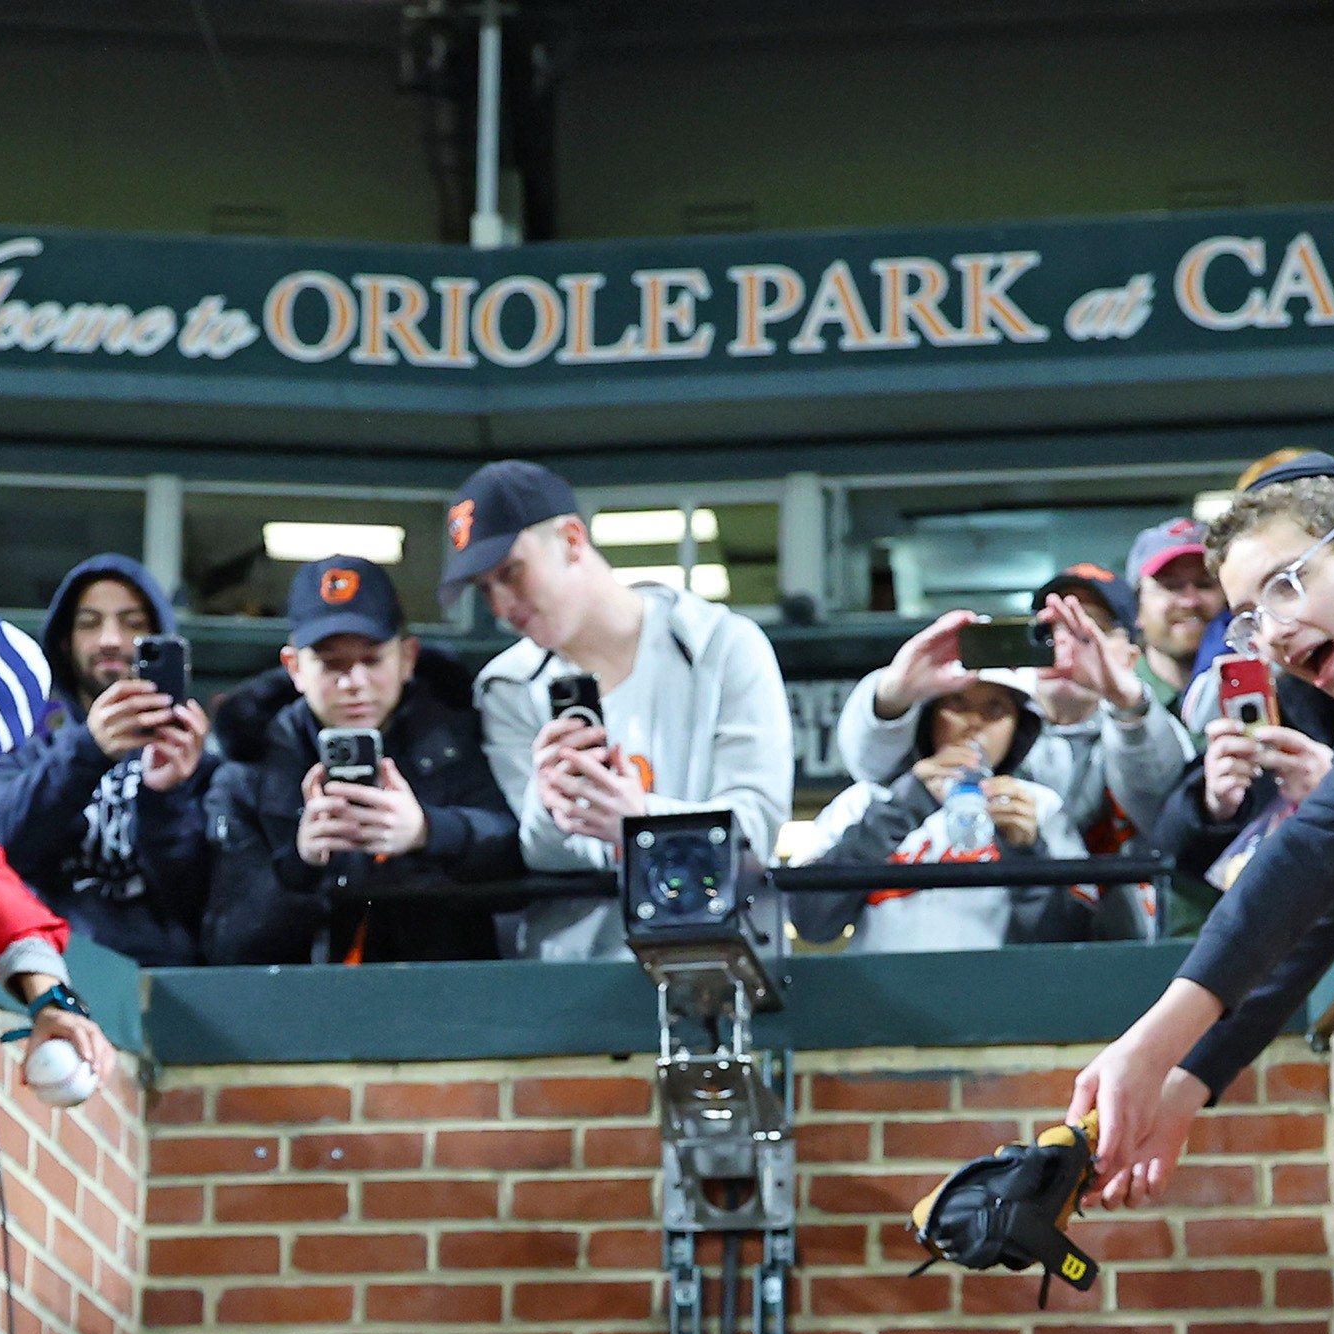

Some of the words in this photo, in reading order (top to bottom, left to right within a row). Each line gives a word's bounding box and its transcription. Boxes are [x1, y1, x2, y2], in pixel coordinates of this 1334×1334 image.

[177, 294, 259, 359] to
[265, 268, 715, 367] ORIOLE
[727, 251, 1049, 355] PARK
[1065, 273, 1154, 339] at
